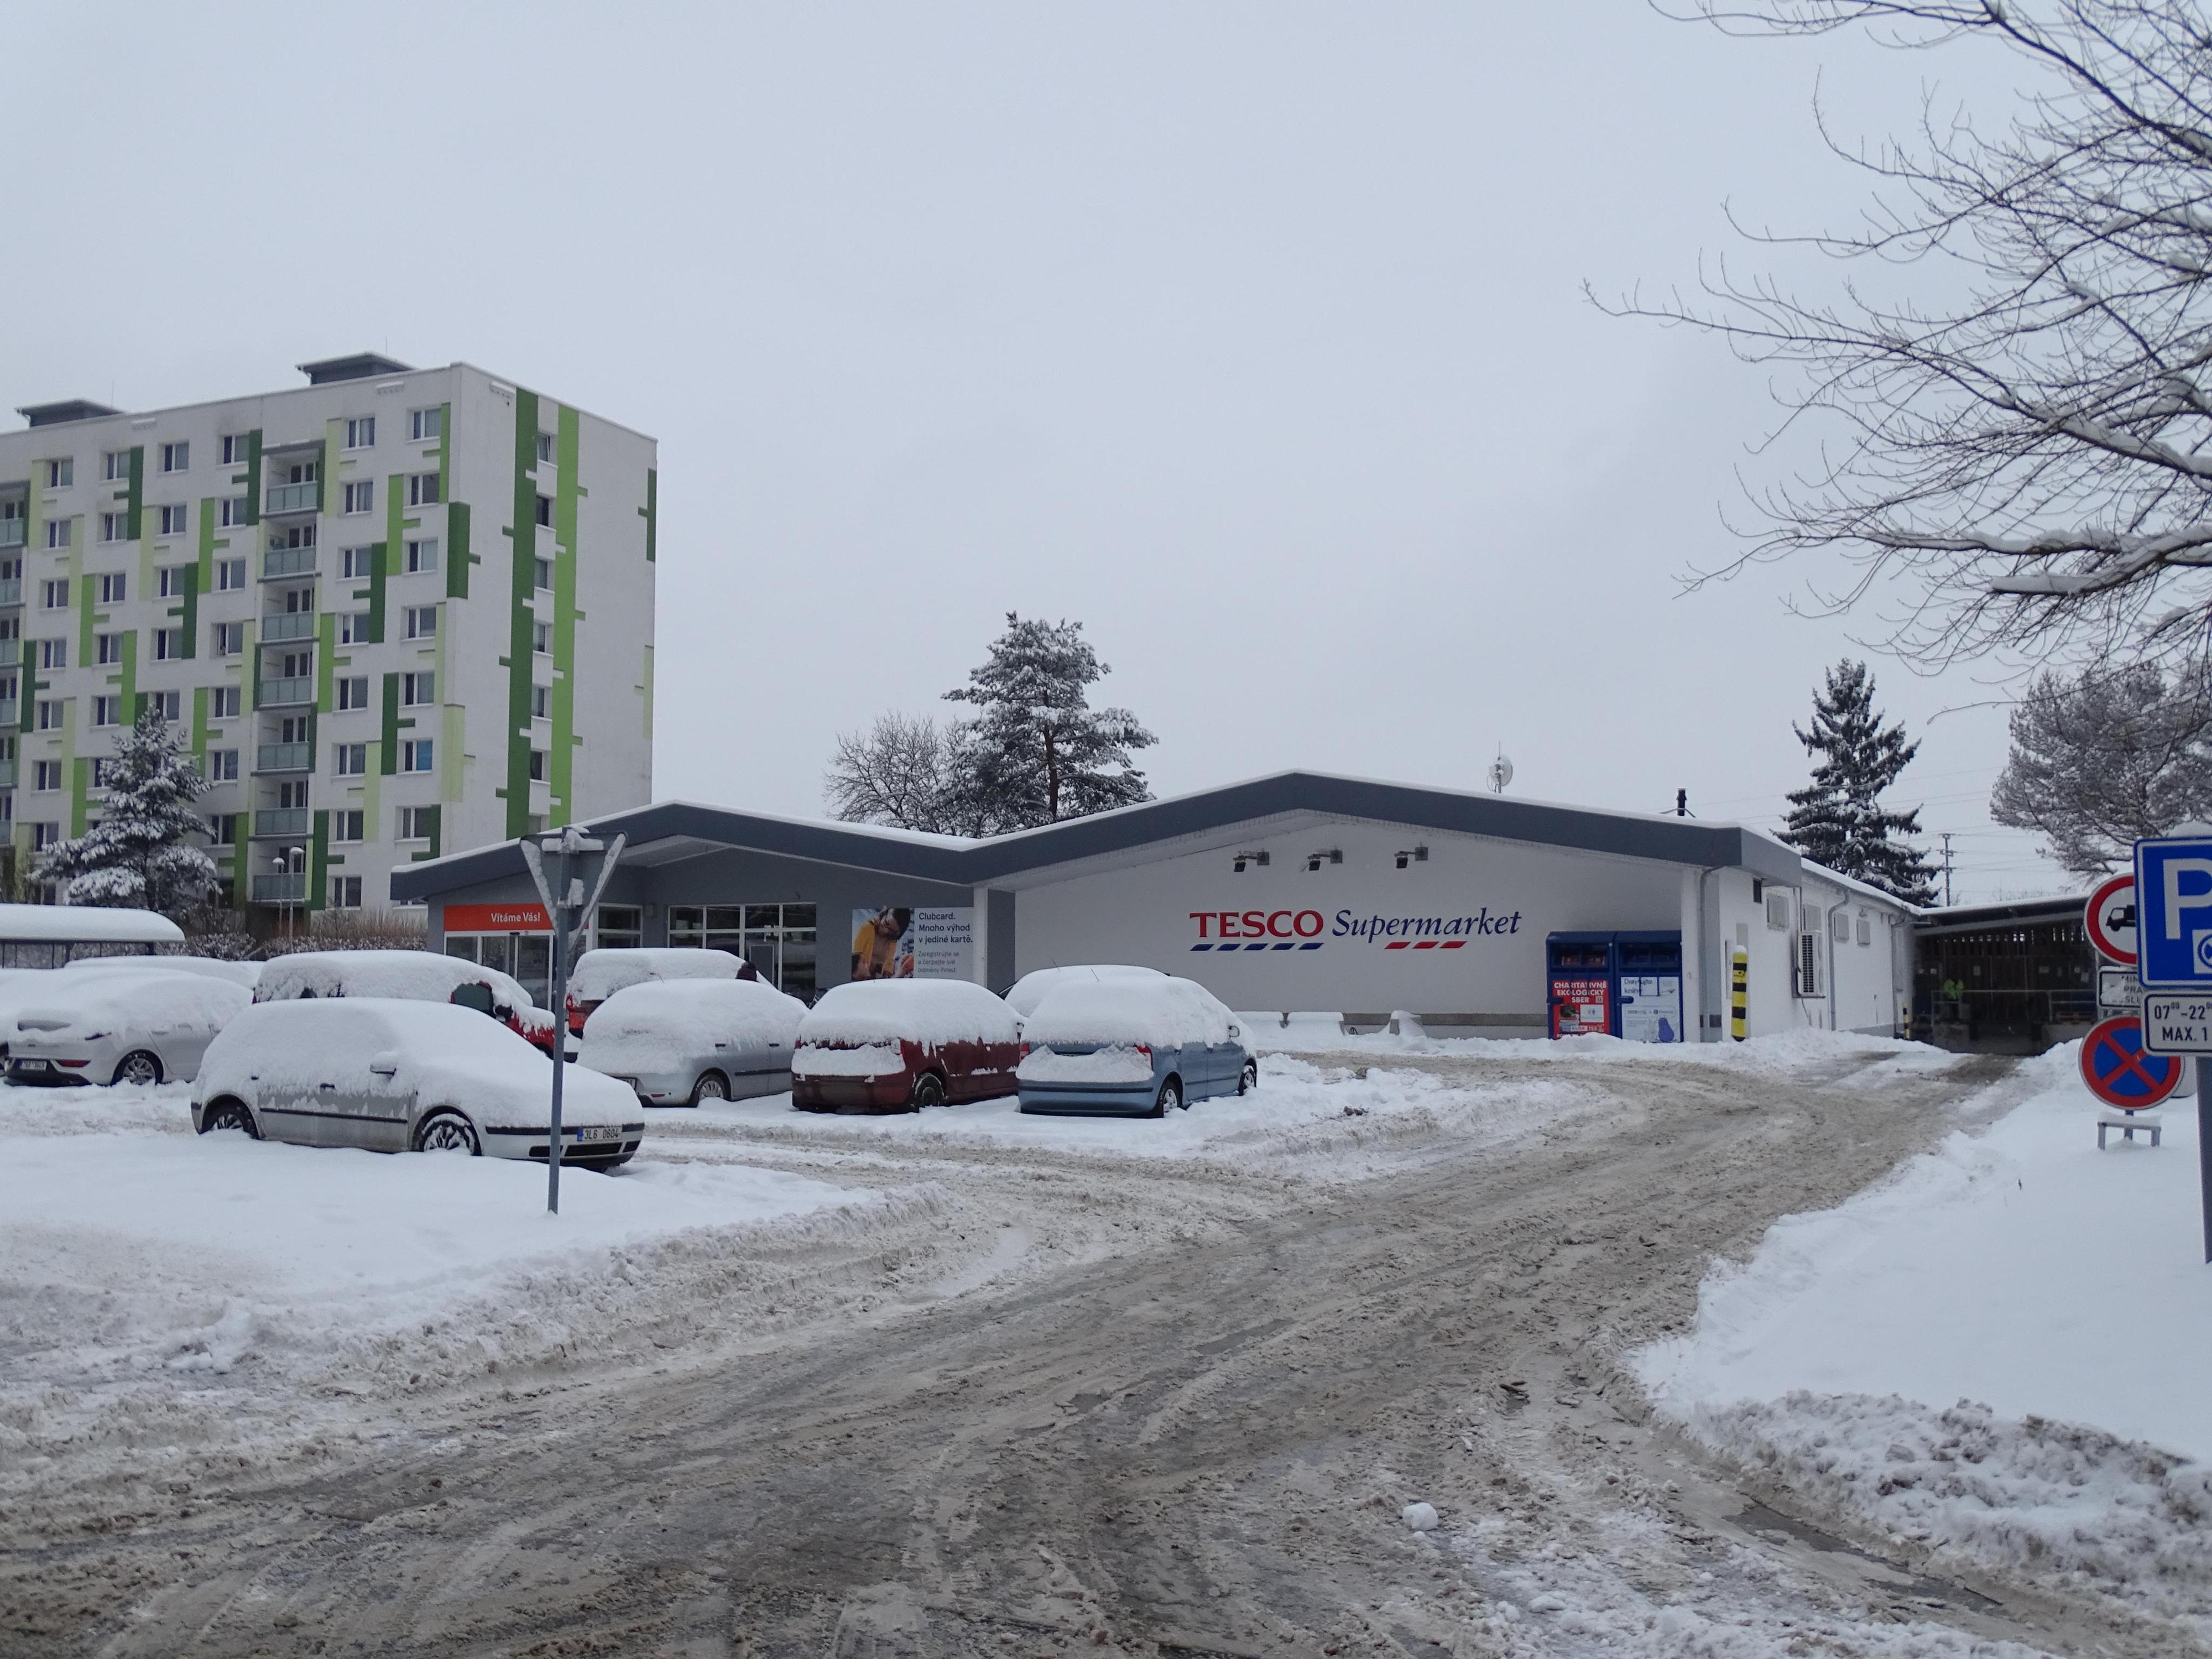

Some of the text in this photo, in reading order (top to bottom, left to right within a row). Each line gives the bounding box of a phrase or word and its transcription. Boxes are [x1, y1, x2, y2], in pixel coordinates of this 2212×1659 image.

[2162, 858, 2212, 940] P
[491, 912, 540, 922] Vítáme Vás!
[919, 912, 955, 920] Clubcard.
[947, 923, 970, 933] výhod
[1190, 907, 1522, 943] TESCO Supermarket
[924, 936, 948, 945] jediné
[951, 935, 973, 943] kartě.
[2162, 1026, 2208, 1041] MAX. 1
[585, 1129, 598, 1139] 3L6
